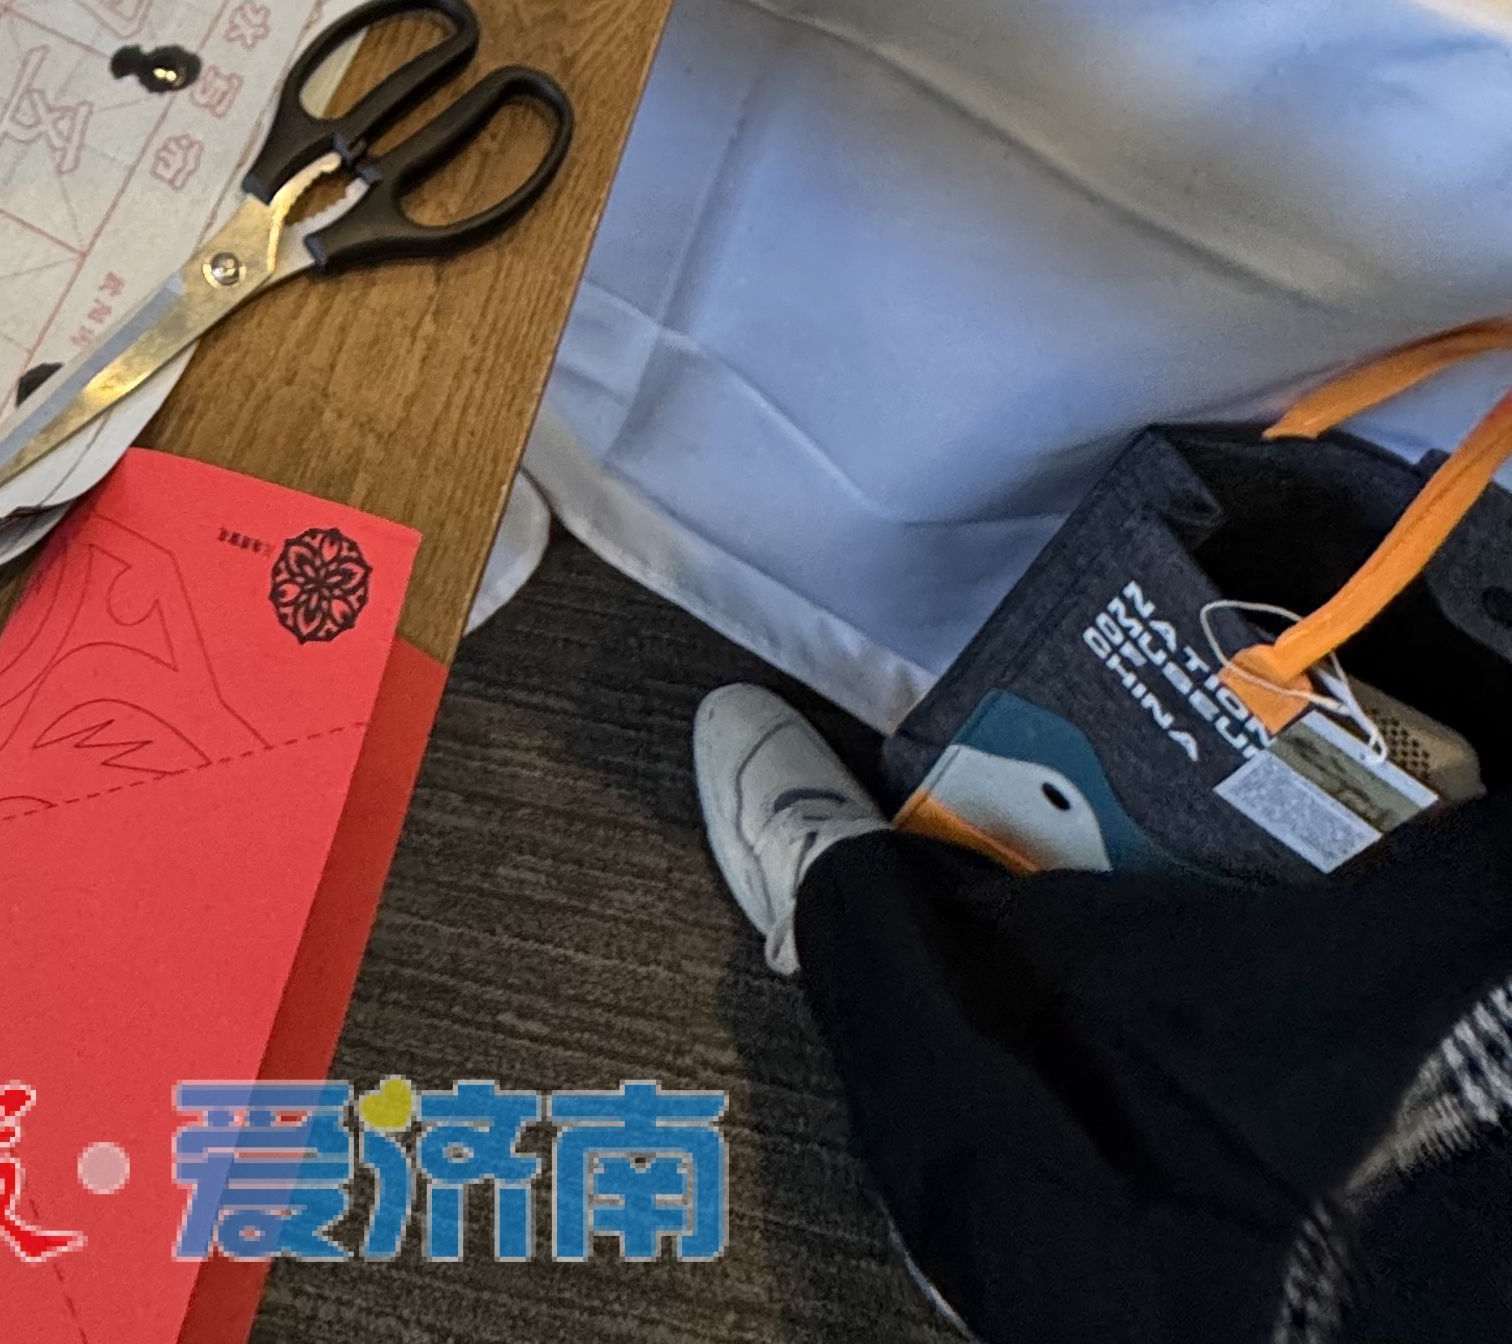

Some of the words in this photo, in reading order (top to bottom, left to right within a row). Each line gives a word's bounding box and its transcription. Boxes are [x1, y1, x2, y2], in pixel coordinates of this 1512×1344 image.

[1083, 626, 1199, 762] CHINA
[1095, 612, 1148, 667] OF
[1122, 580, 1276, 748] NATION
